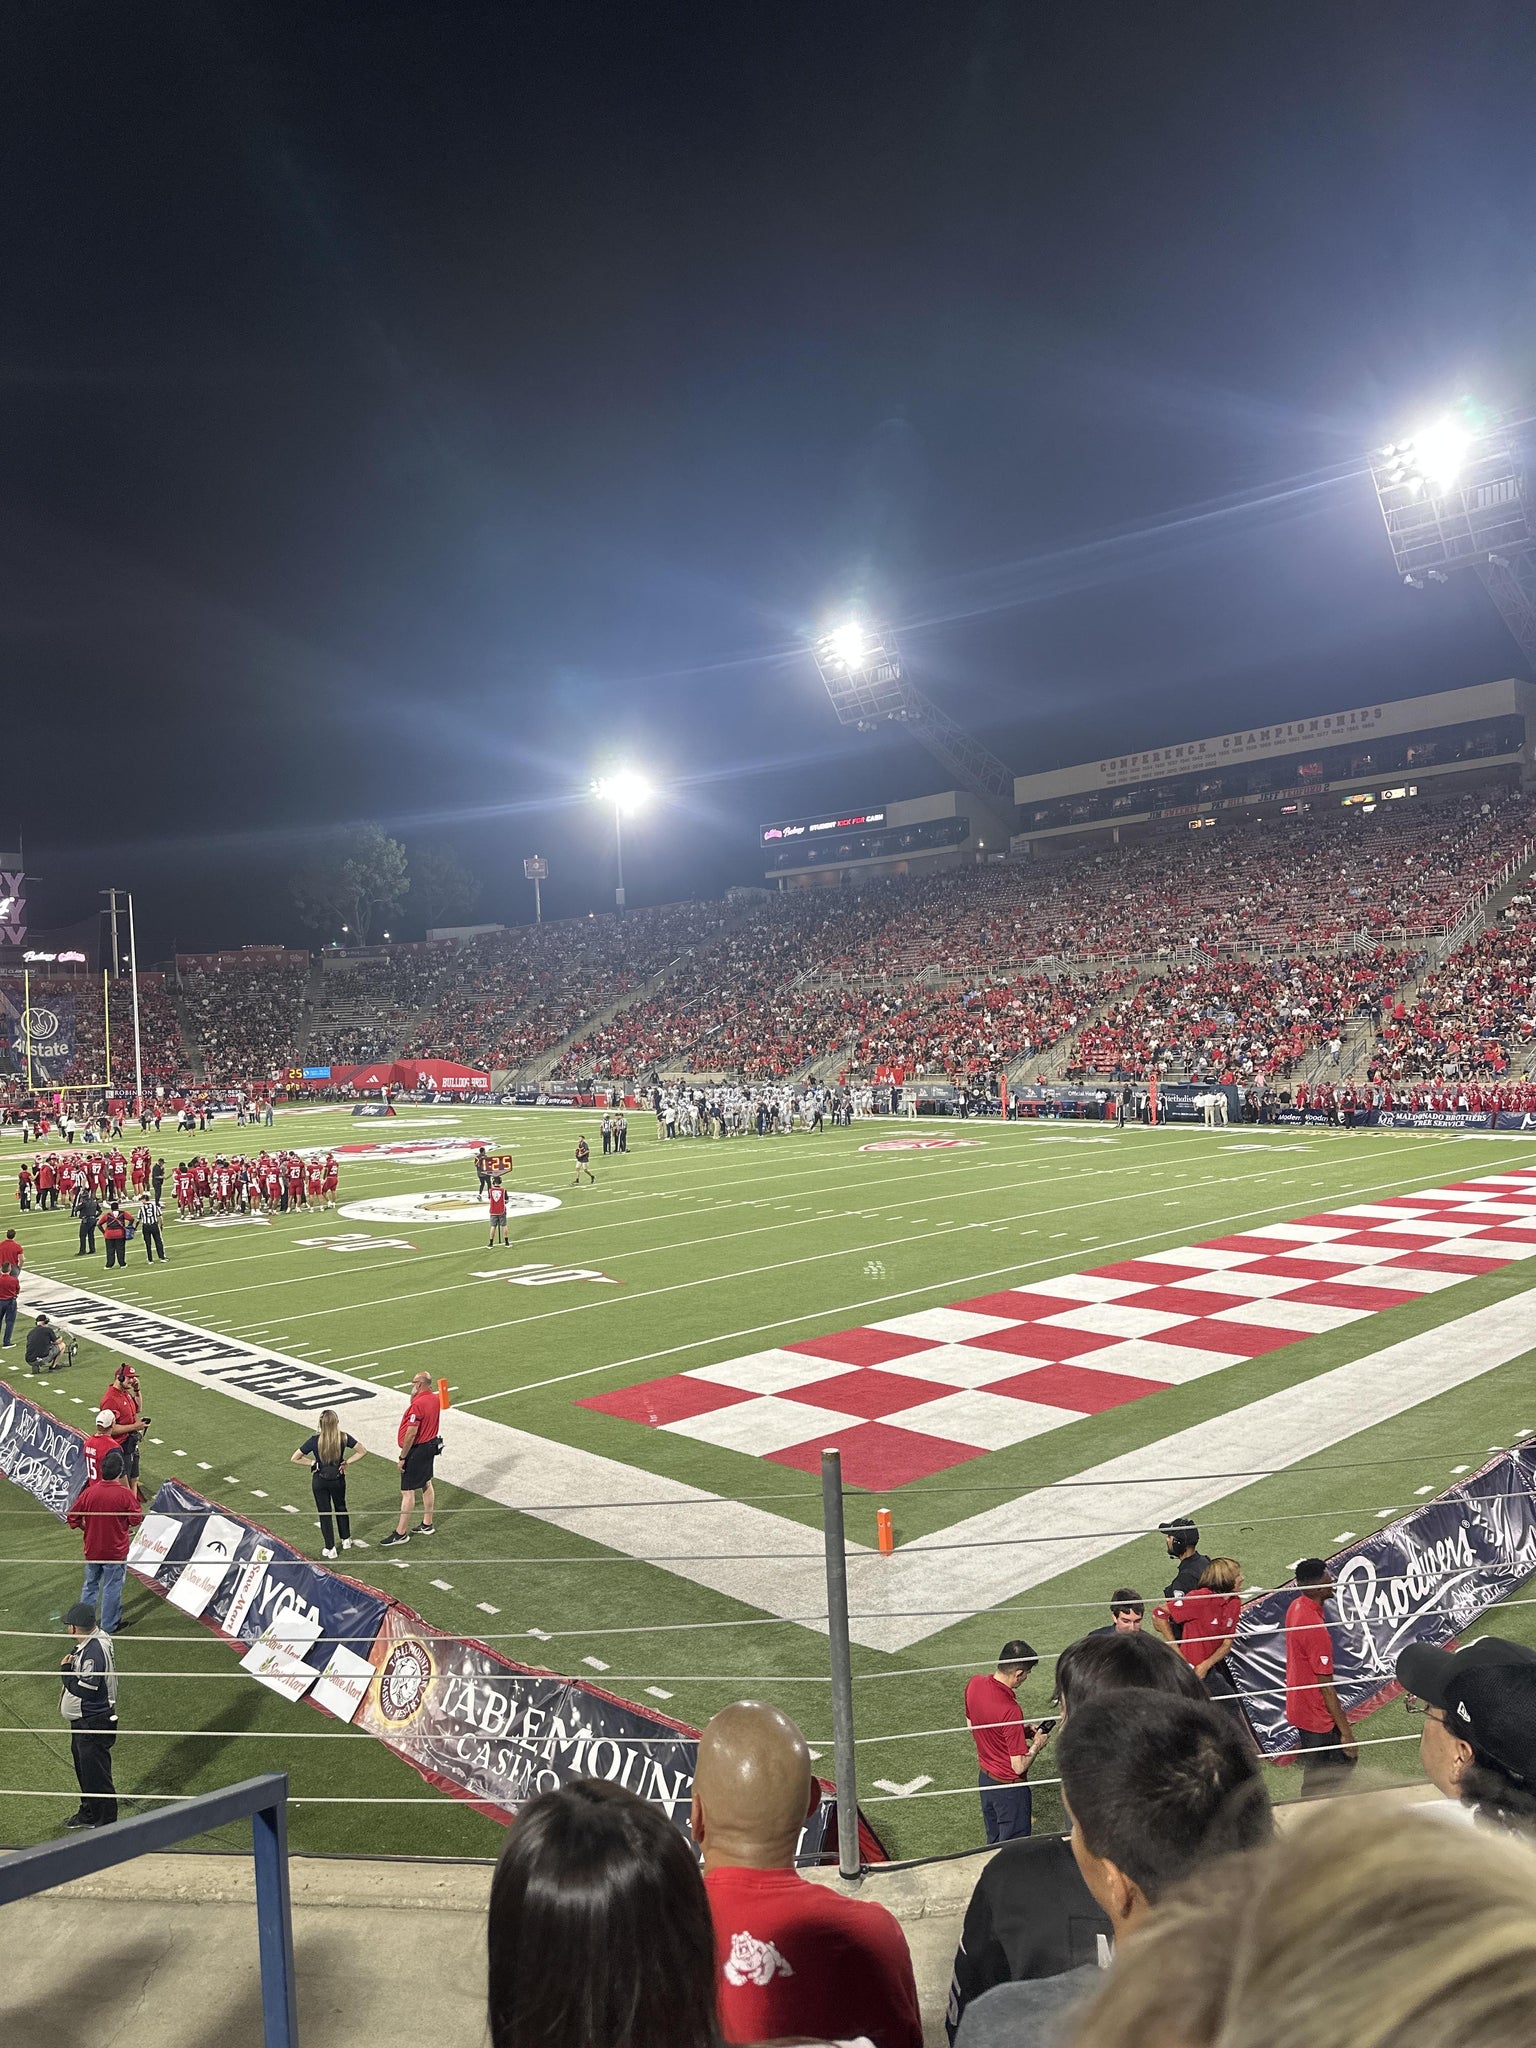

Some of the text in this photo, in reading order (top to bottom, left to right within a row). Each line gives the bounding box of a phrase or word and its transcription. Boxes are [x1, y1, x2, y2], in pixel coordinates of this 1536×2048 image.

[1100, 708, 1382, 772] CONFERENCE CHAMPIONSHIPS
[1211, 800, 1225, 809] PAT
[1257, 791, 1280, 802] JEFF
[1148, 805, 1200, 820] JIM SWEENEY
[809, 813, 884, 831] STUDENT KICK FOR CASH
[288, 1068, 303, 1079] 25
[442, 1077, 470, 1088] BULLDOG
[1396, 1112, 1487, 1122] MALDONADO BROTHERS
[1413, 1119, 1433, 1127] TREE
[482, 1156, 512, 1171] 1:25
[289, 1168, 301, 1179] 43
[180, 1180, 190, 1190] 17
[146, 1207, 153, 1217] S
[467, 1263, 606, 1286] 10
[27, 1297, 378, 1411] JIM SWEENEY FIELD
[86, 1456, 98, 1480] 15
[150, 1539, 168, 1556] Mart
[226, 1563, 261, 1631] Save Mart
[229, 1557, 320, 1625] TYOTA
[1336, 1524, 1477, 1673] Producers
[282, 1672, 307, 1693] Mart
[328, 1669, 363, 1700] Save Mart
[382, 1677, 393, 1713] CASINO
[439, 1671, 694, 1821] TABLE MOUN
[456, 1733, 561, 1796] CASINO
